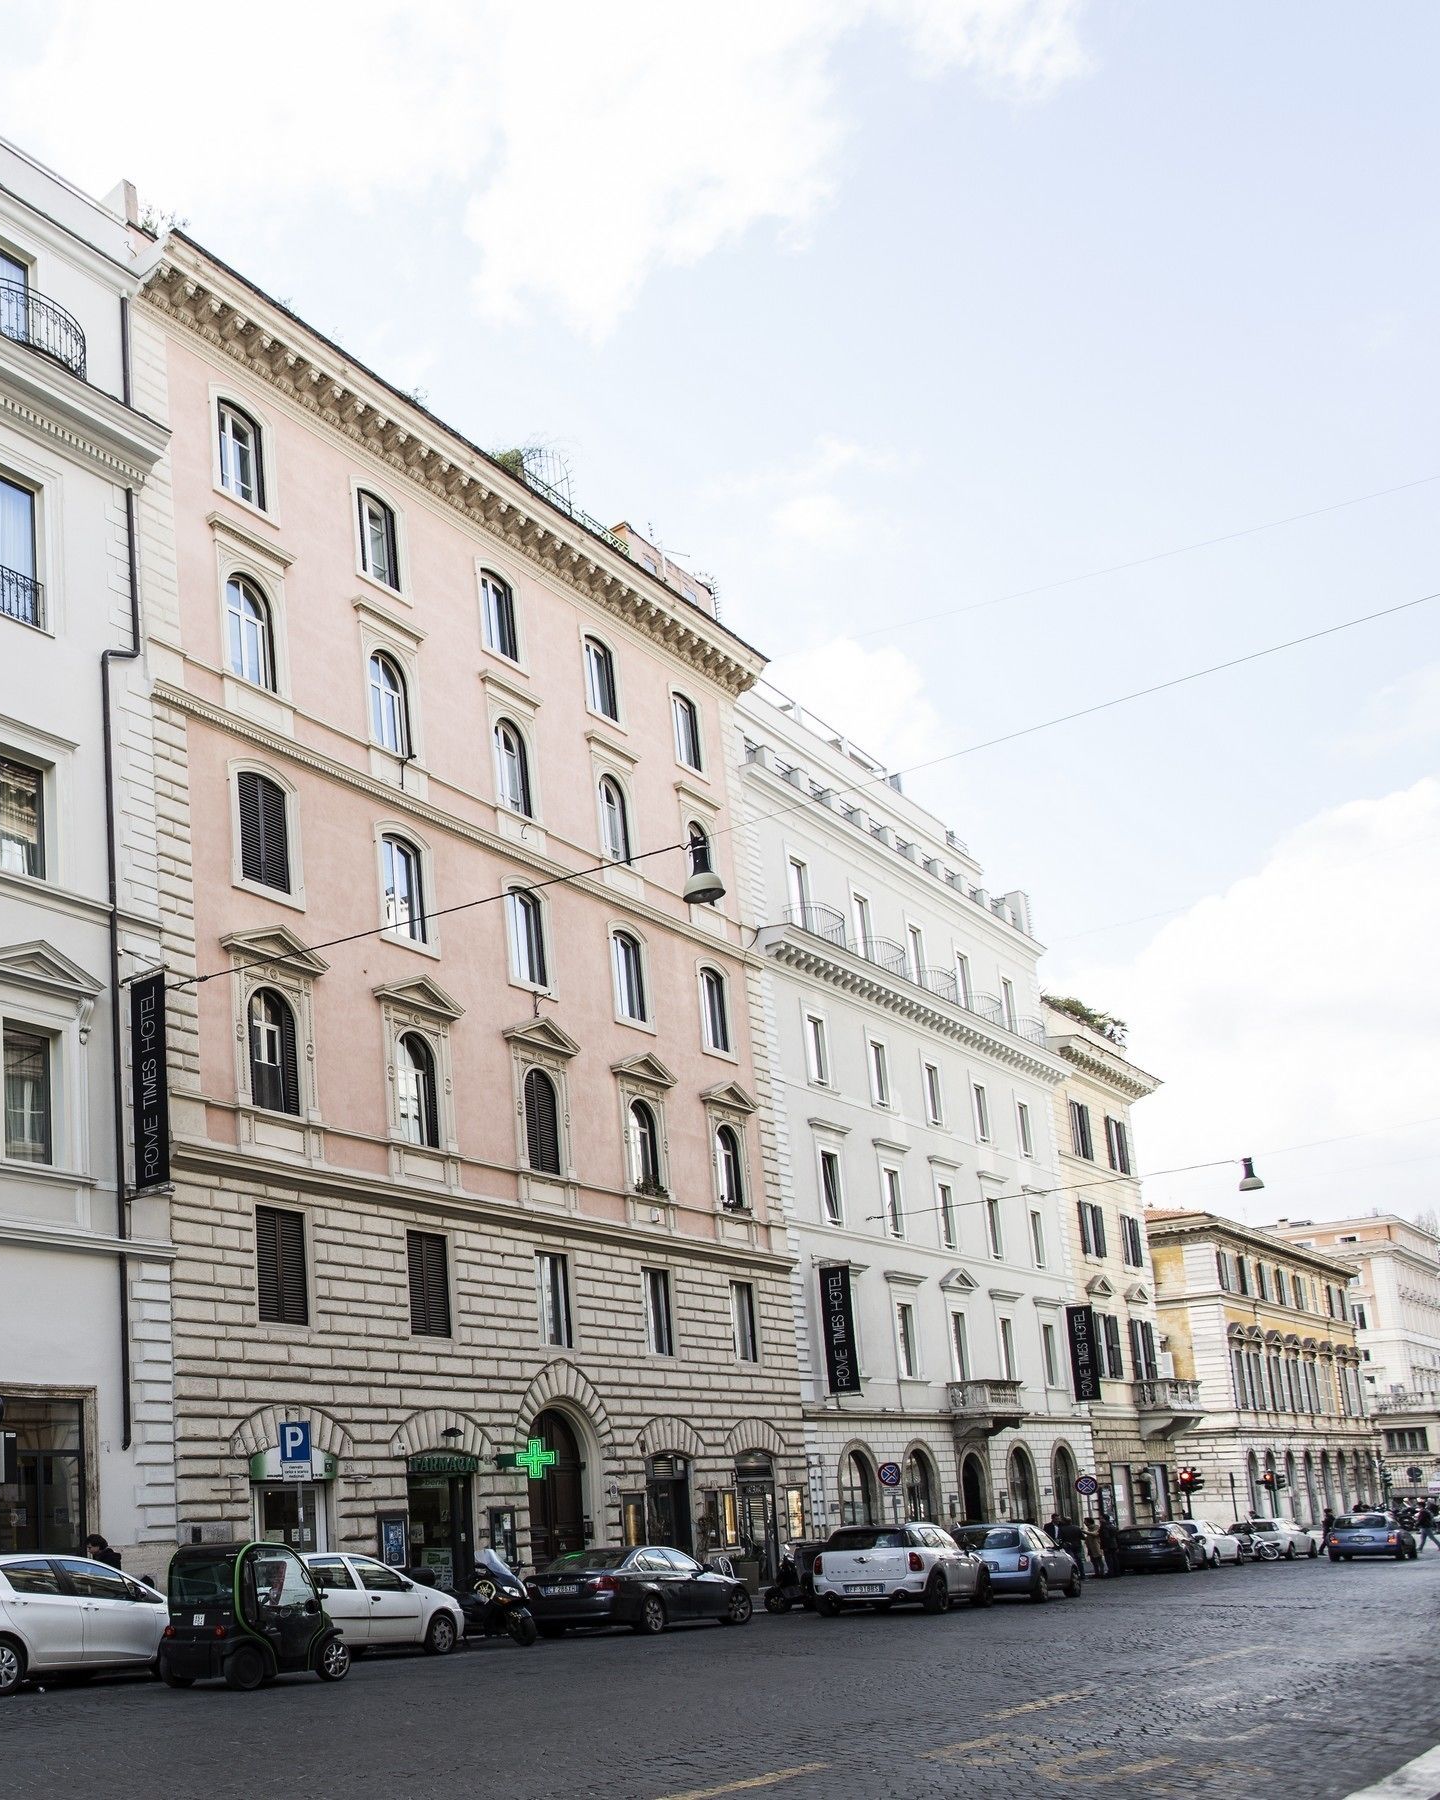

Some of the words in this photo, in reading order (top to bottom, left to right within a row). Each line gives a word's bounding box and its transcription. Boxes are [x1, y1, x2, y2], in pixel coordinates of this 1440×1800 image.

[140, 986, 156, 1054] HOTEL
[142, 1058, 157, 1110] TIMES
[144, 1114, 159, 1179] ROME
[828, 1271, 843, 1311] HOTEL
[831, 1314, 847, 1345] TIMES
[1073, 1310, 1087, 1341] HOTEL
[835, 1348, 850, 1387] ROME
[1076, 1342, 1090, 1365] TIMES
[1080, 1368, 1093, 1397] ROME
[285, 1426, 304, 1458] P
